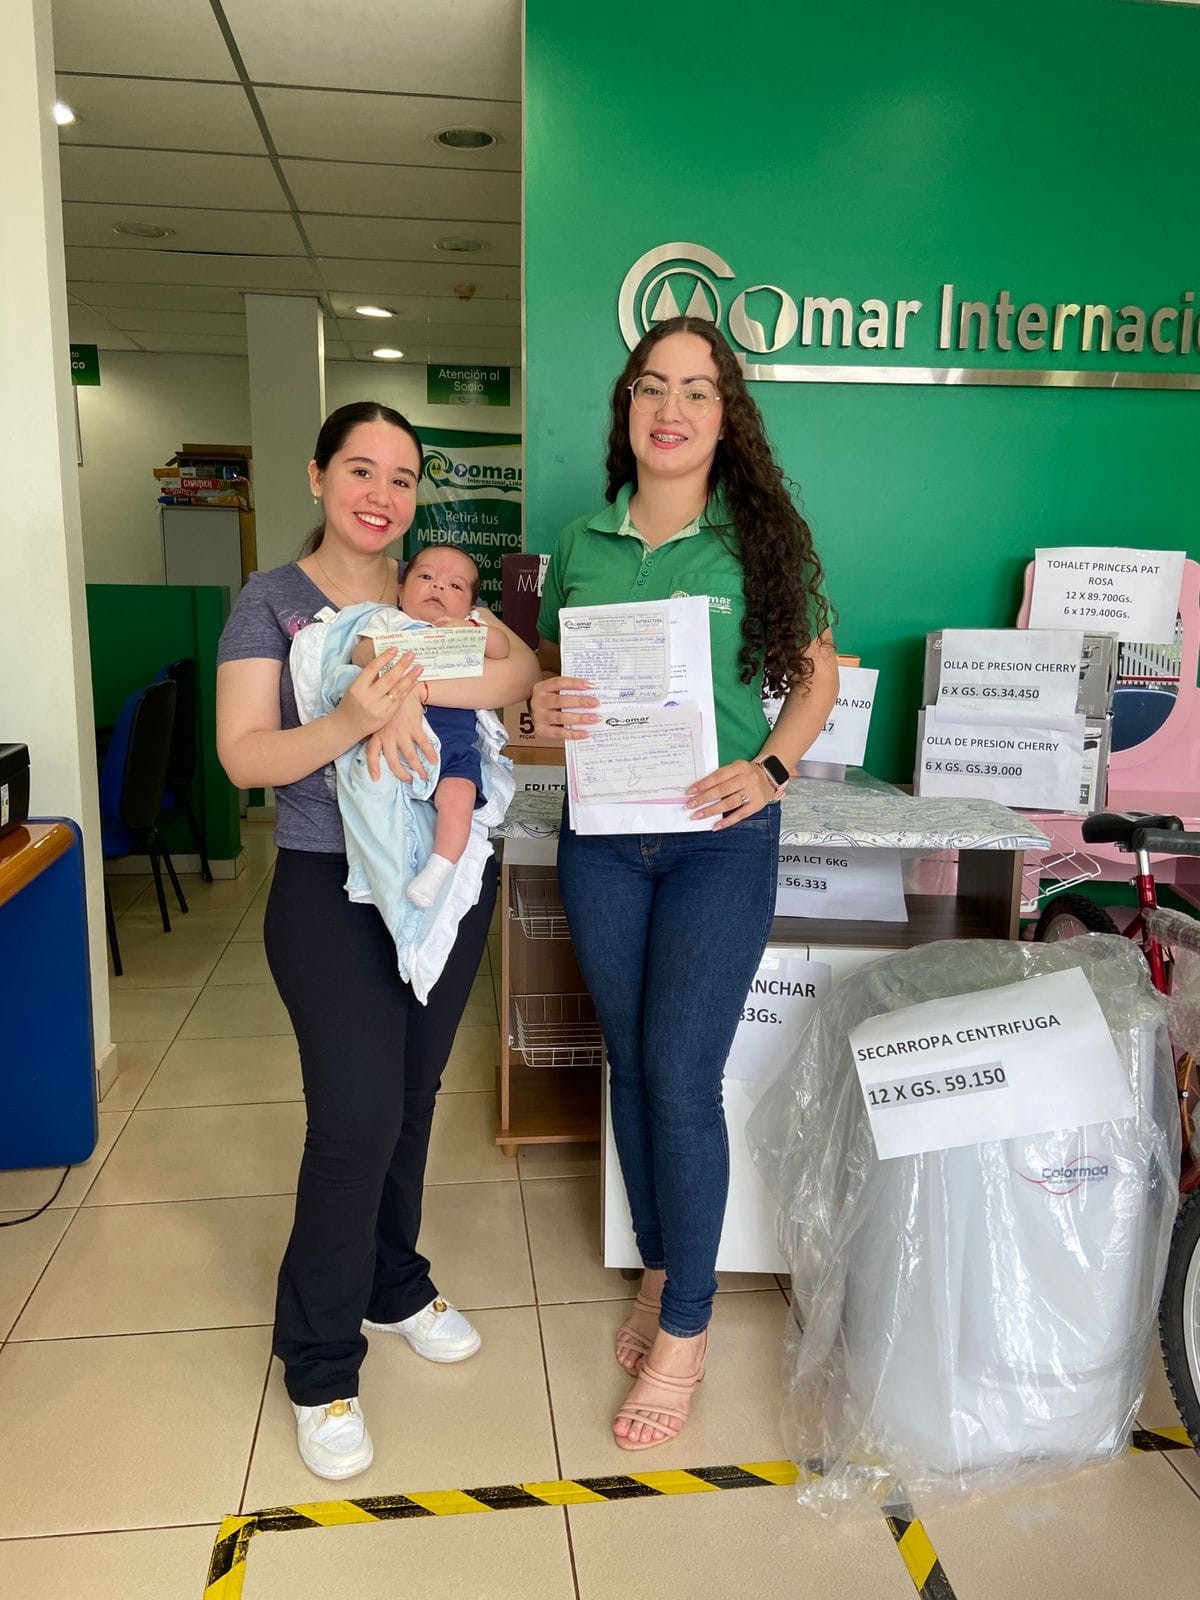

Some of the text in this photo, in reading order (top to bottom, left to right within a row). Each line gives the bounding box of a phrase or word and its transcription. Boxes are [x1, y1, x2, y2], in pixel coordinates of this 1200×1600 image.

[939, 284, 1200, 354] Internaci
[438, 368, 500, 381] Atención al
[454, 381, 484, 392] Socio
[445, 510, 499, 525] Retirá tus
[1047, 560, 1160, 575] TOHALET PRINCESA PAT
[1088, 576, 1114, 586] ROSA
[1065, 591, 1133, 603] 12 X 89.700Gs.
[1063, 606, 1070, 615] 6
[1079, 608, 1130, 619] 179.400Gs.
[943, 660, 1077, 673] OLLA DE PRESION CHERRY
[941, 686, 1040, 699] 6 X GS. GS.34.450
[851, 699, 871, 709] N20
[519, 712, 535, 734] 5
[926, 736, 1059, 751] OLLA DE PRESION CHERRY
[925, 761, 1023, 776] 6 X GS. GS.39.000
[826, 858, 848, 867] 6KG
[786, 877, 827, 890] 56.333
[857, 1014, 1061, 1062] SECARROPA CENTRIFUGA
[868, 1067, 1006, 1105] 12 X GS. 59.150
